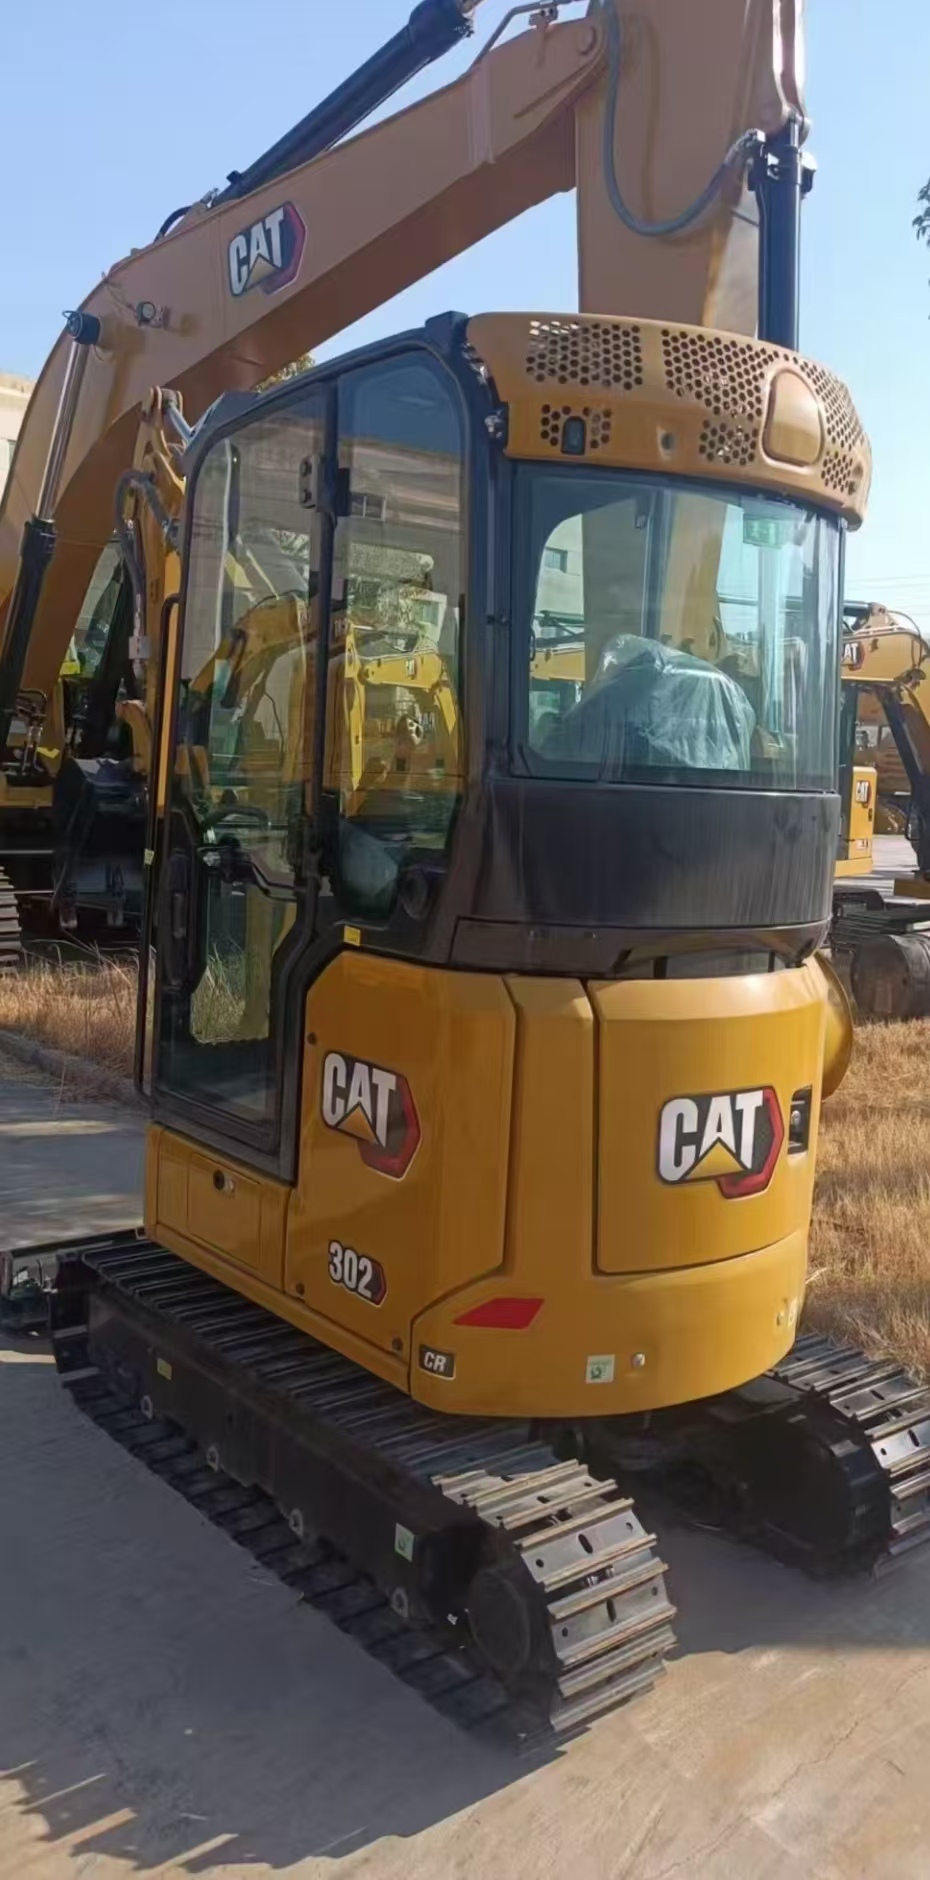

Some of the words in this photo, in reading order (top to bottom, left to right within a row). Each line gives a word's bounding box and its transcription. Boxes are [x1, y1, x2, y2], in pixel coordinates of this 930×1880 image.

[229, 207, 285, 295] CAT
[843, 642, 858, 664] AT
[322, 1052, 397, 1148] CAT
[658, 1089, 764, 1181] CAT
[329, 1241, 373, 1299] 302
[423, 1351, 447, 1372] CR
